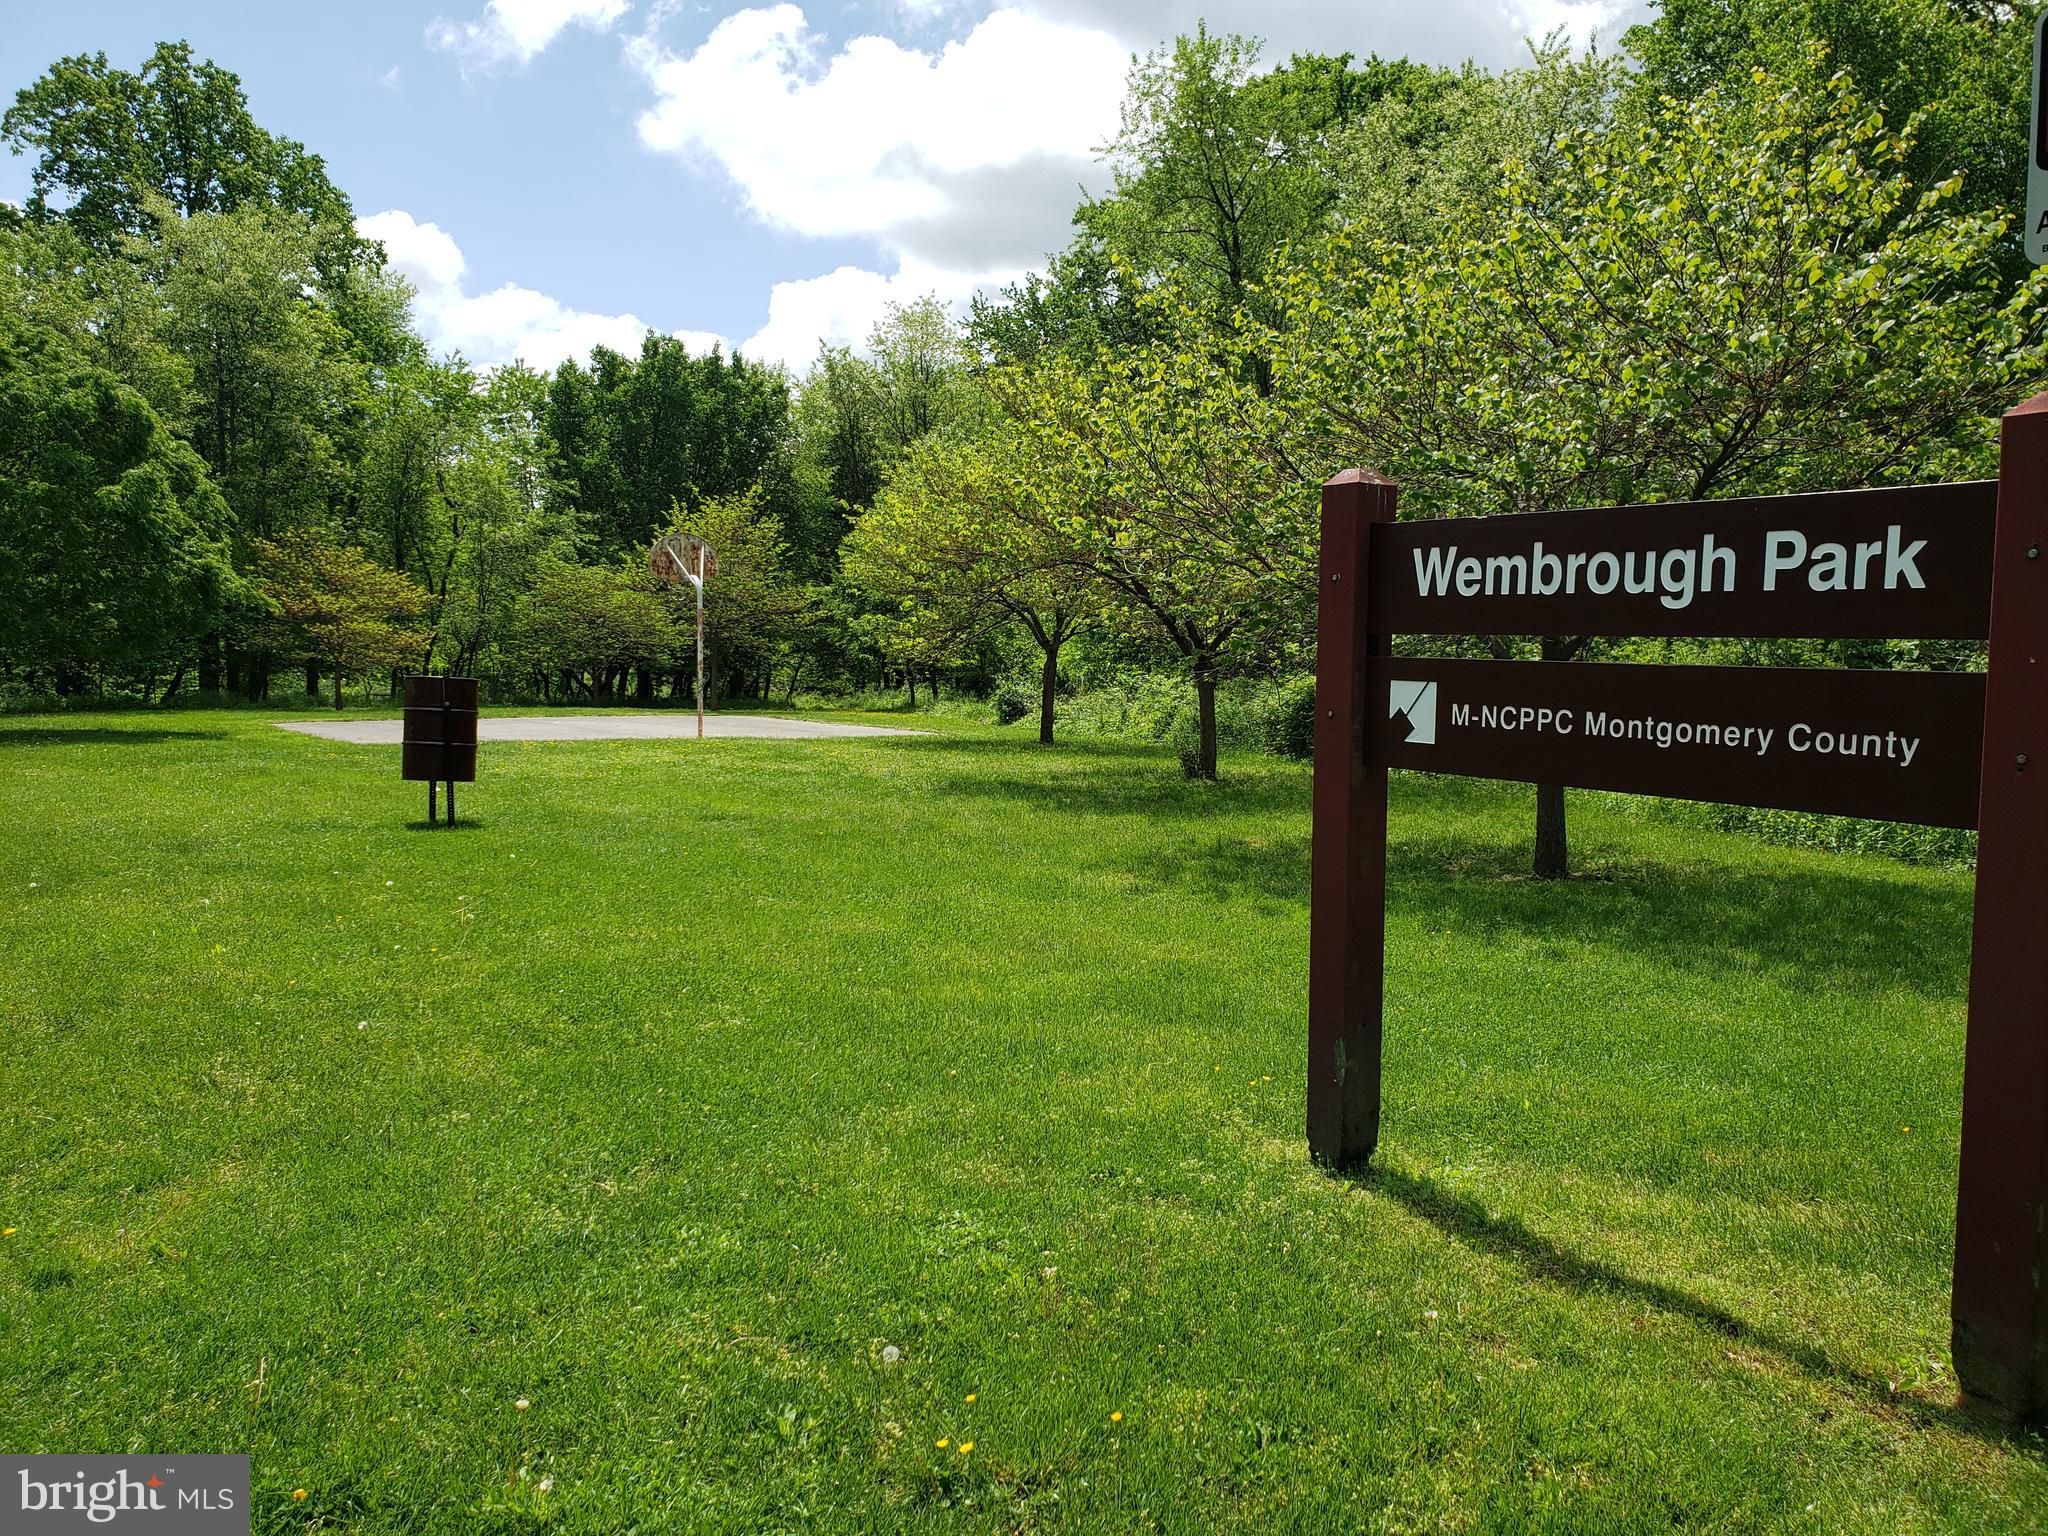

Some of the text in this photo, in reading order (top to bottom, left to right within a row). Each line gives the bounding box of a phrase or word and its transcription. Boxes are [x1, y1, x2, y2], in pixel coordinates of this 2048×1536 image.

[1412, 524, 1927, 610] Wembrough Park
[1451, 703, 1920, 767] M-NCPPC Montgomery County
